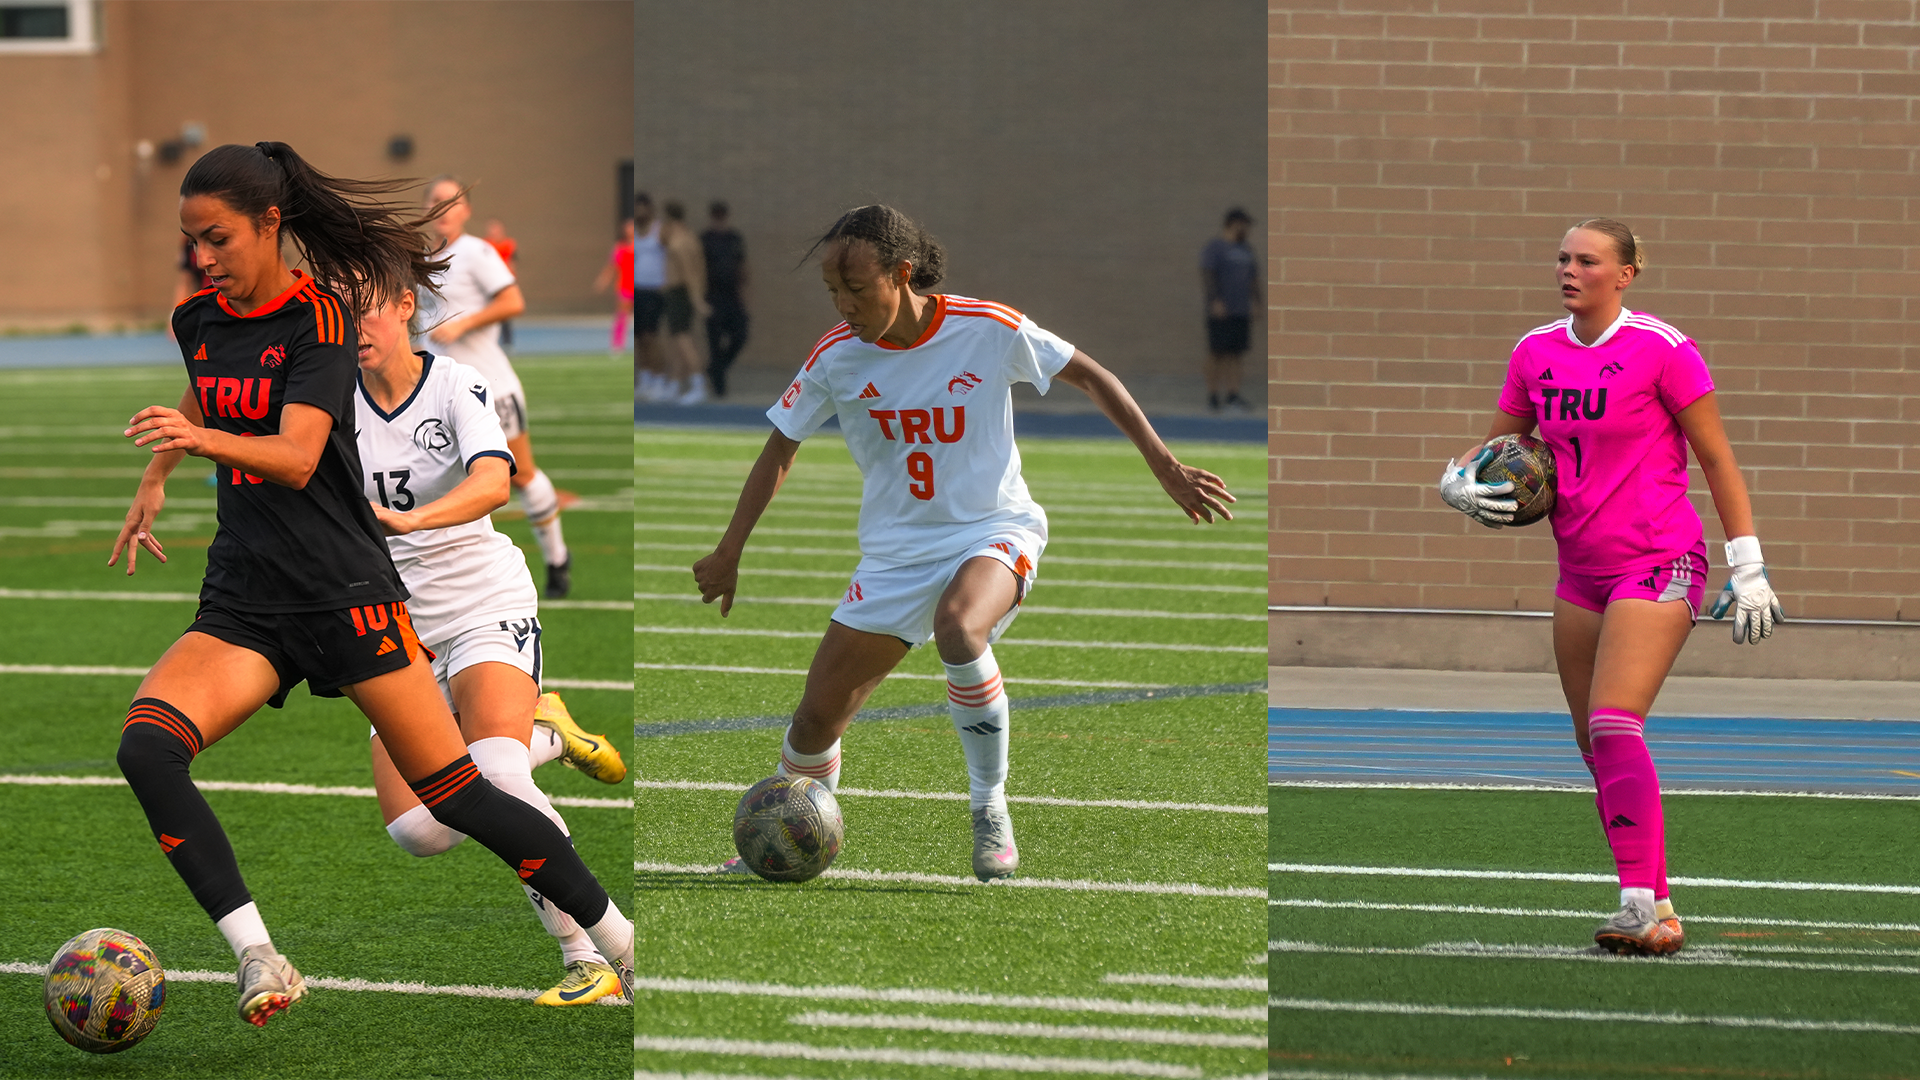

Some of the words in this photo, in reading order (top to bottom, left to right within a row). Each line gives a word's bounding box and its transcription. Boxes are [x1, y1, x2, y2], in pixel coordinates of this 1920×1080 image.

[197, 376, 272, 420] TRU
[1541, 388, 1608, 421] TRU
[868, 406, 965, 444] TRU
[907, 452, 935, 501] 9
[1569, 437, 1582, 478] 1
[373, 470, 415, 511] 13
